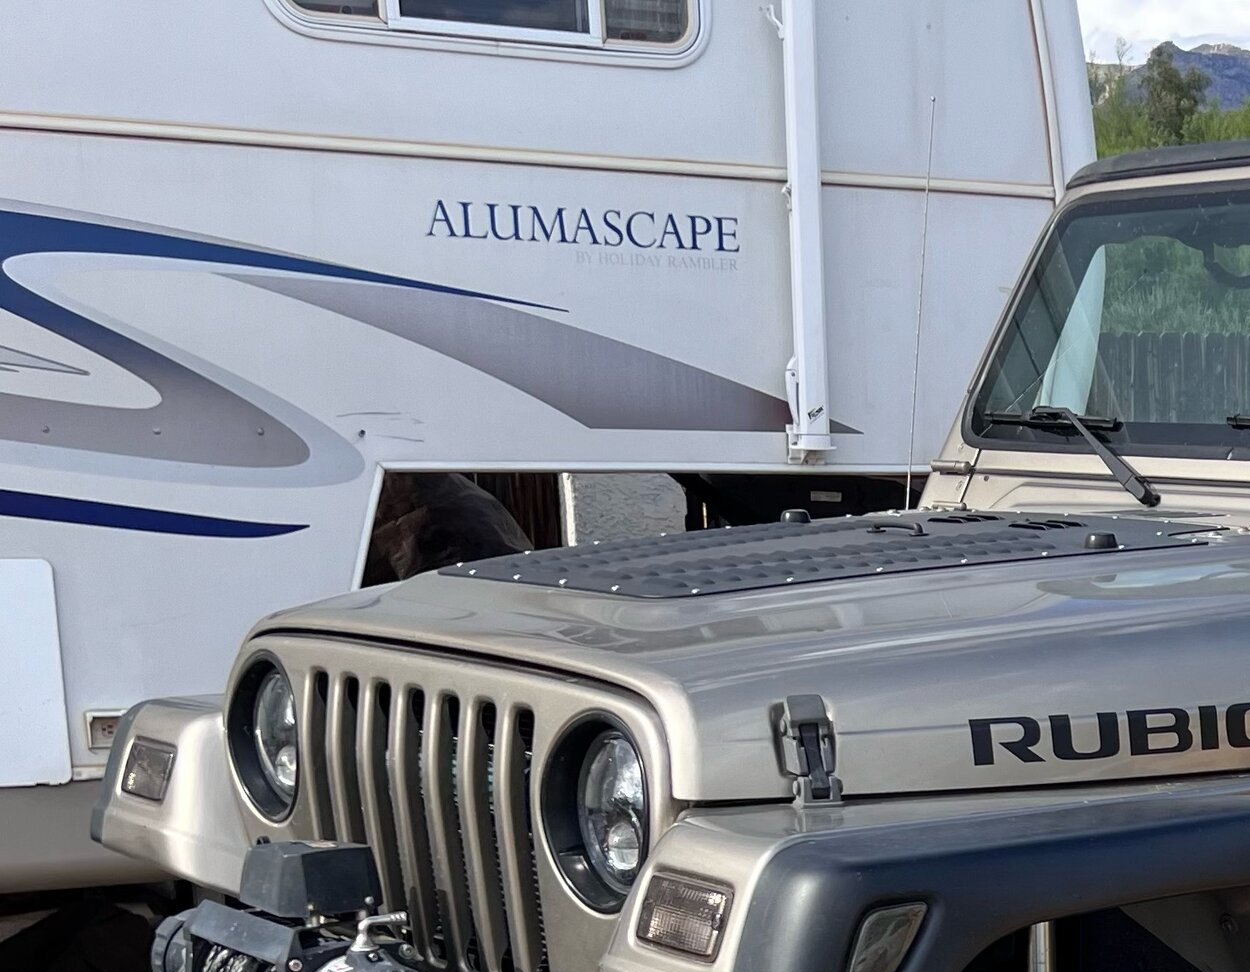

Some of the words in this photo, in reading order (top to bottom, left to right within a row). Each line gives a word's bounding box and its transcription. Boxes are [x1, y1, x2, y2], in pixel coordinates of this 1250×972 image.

[426, 199, 741, 253] ALUMASCAPE
[576, 250, 593, 264] BY
[599, 252, 663, 268] HOLIDAY
[667, 256, 739, 272] RAMBLER
